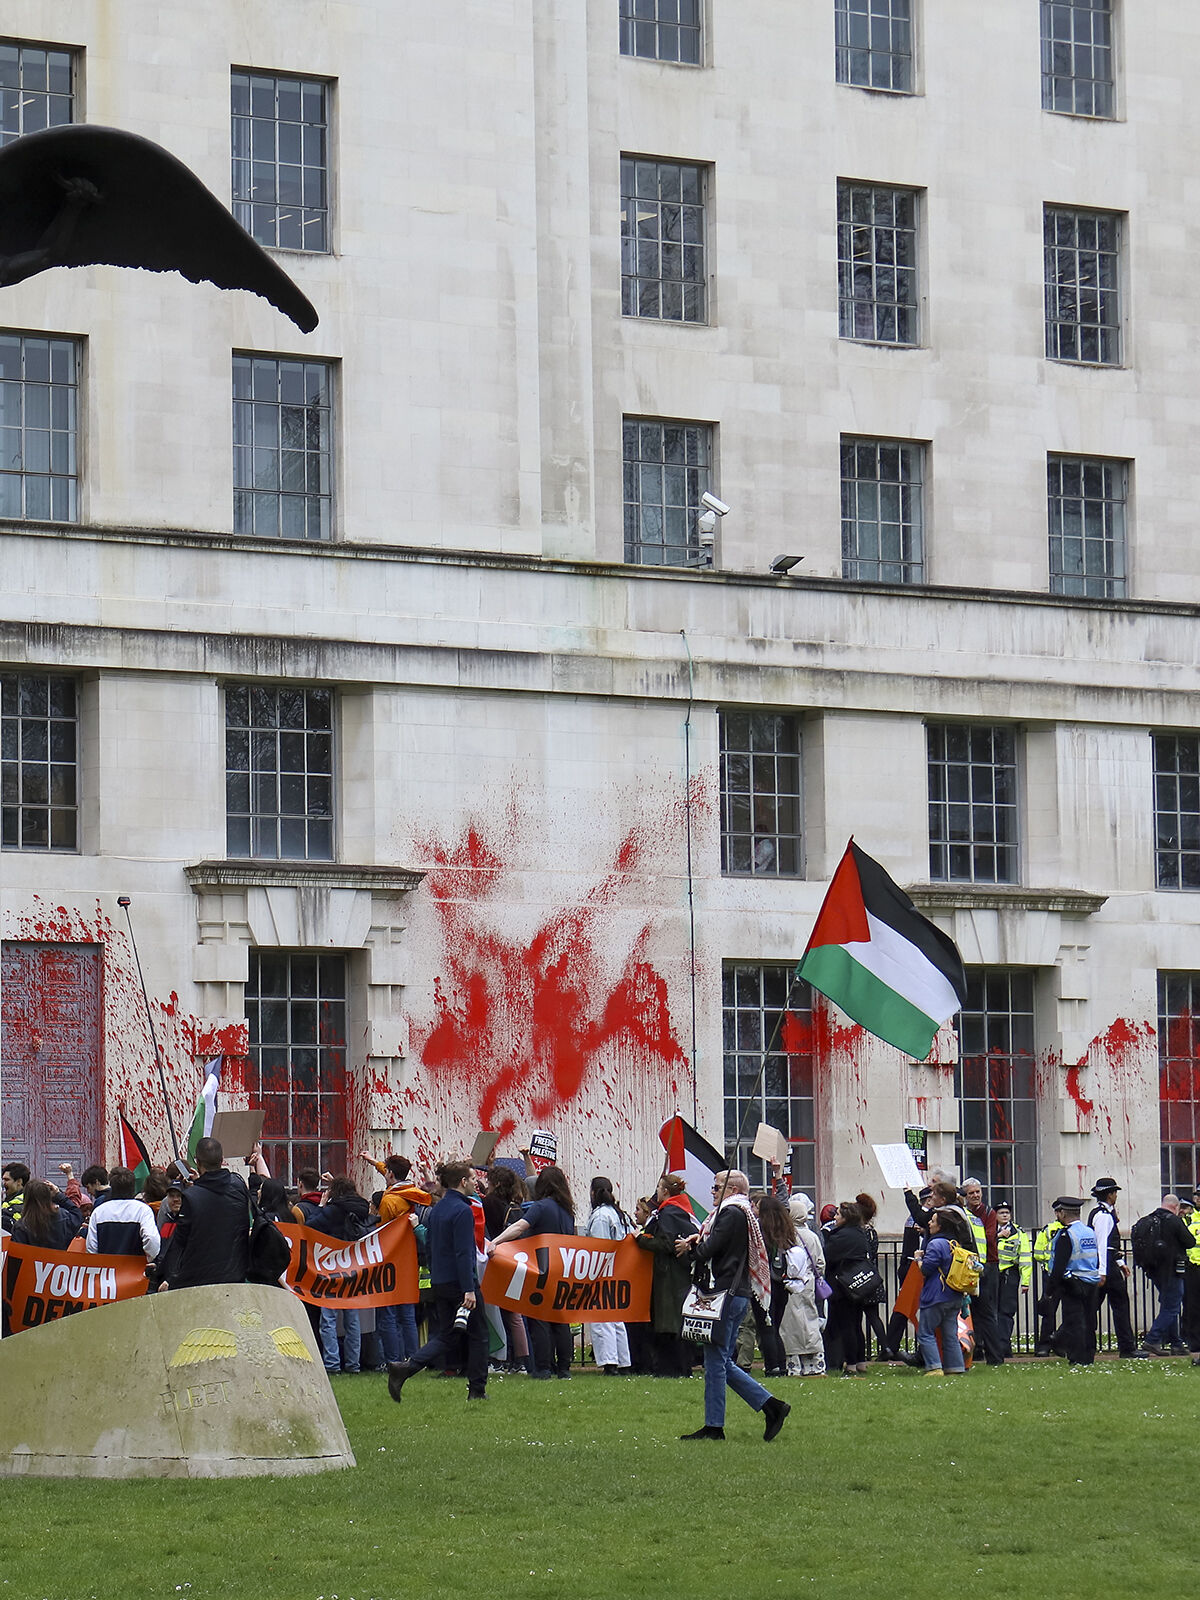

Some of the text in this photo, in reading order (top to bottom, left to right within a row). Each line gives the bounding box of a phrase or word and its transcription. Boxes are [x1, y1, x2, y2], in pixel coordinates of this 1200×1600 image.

[531, 1147, 556, 1160] PALESTINE
[313, 1233, 383, 1271] YOUTH
[34, 1261, 117, 1300] YOUTH
[310, 1263, 396, 1298] DEMAND
[849, 1278, 863, 1289] TOTE
[863, 1271, 874, 1280] BAG
[853, 1271, 865, 1280] THE
[552, 1280, 631, 1310] DEMAND
[685, 1319, 712, 1329] WAR
